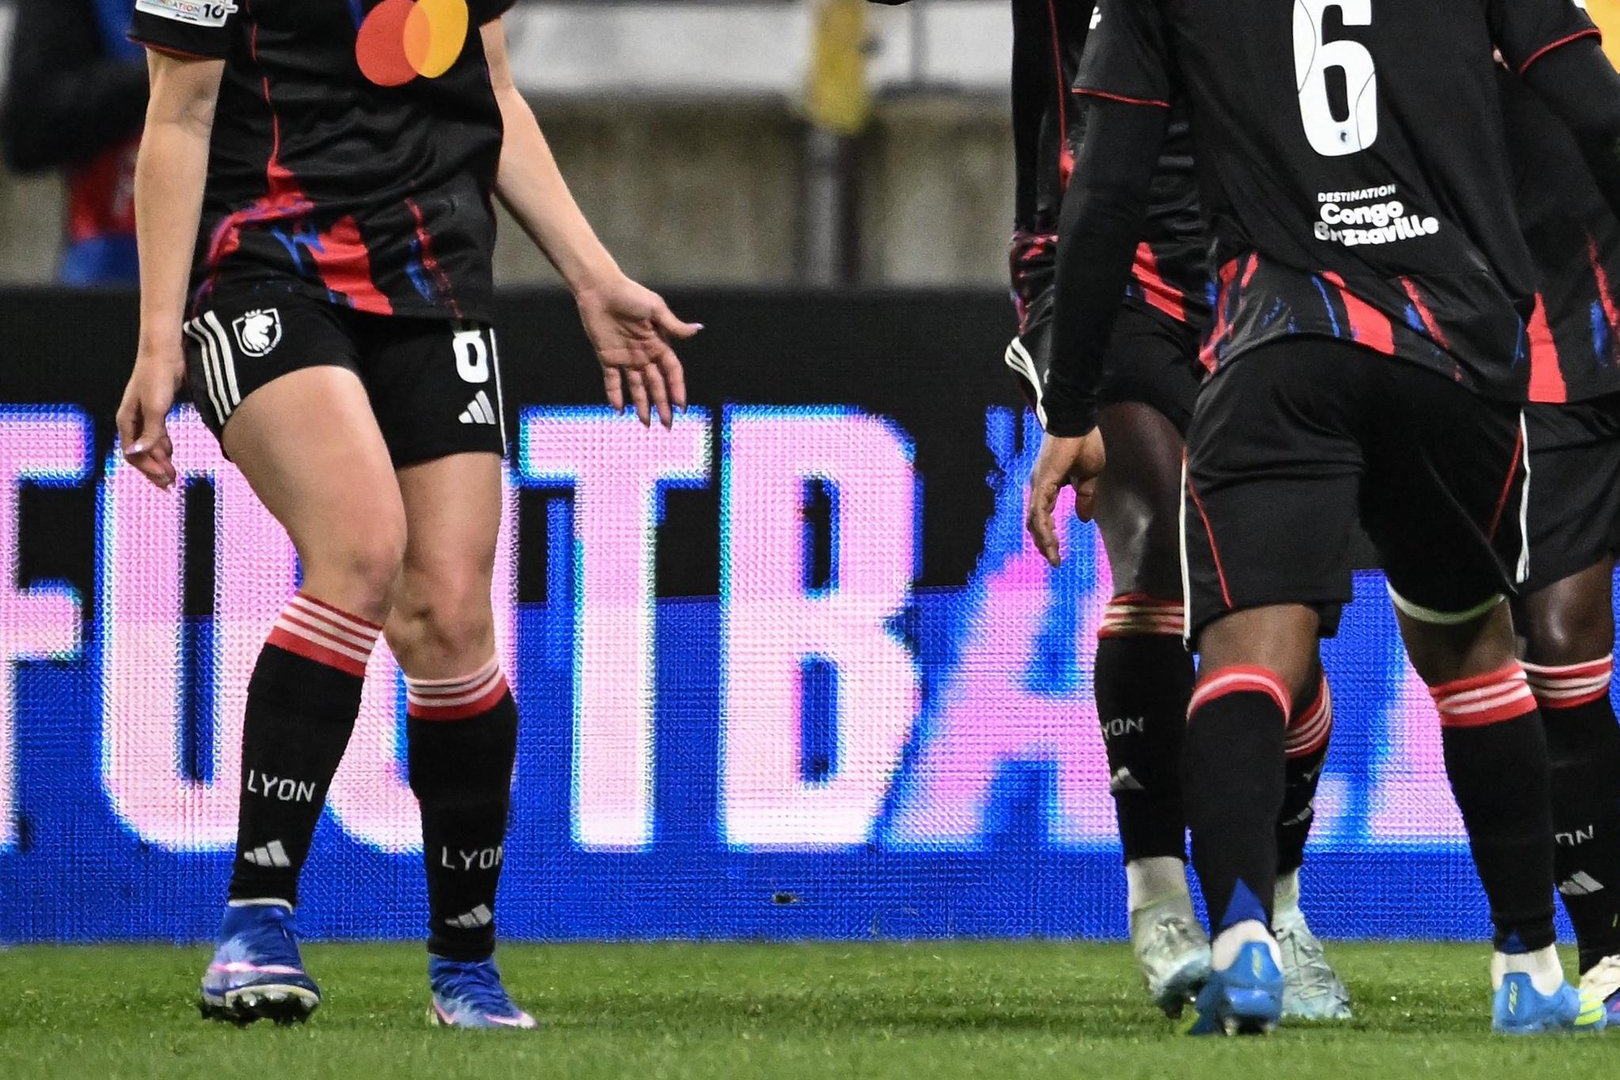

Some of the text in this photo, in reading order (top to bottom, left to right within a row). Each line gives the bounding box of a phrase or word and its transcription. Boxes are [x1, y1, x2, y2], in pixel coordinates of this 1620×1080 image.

[1317, 183, 1396, 203] DESTINATION
[1320, 201, 1404, 228] Congo
[1314, 215, 1439, 247] Brzzaville
[247, 769, 316, 803] LYON
